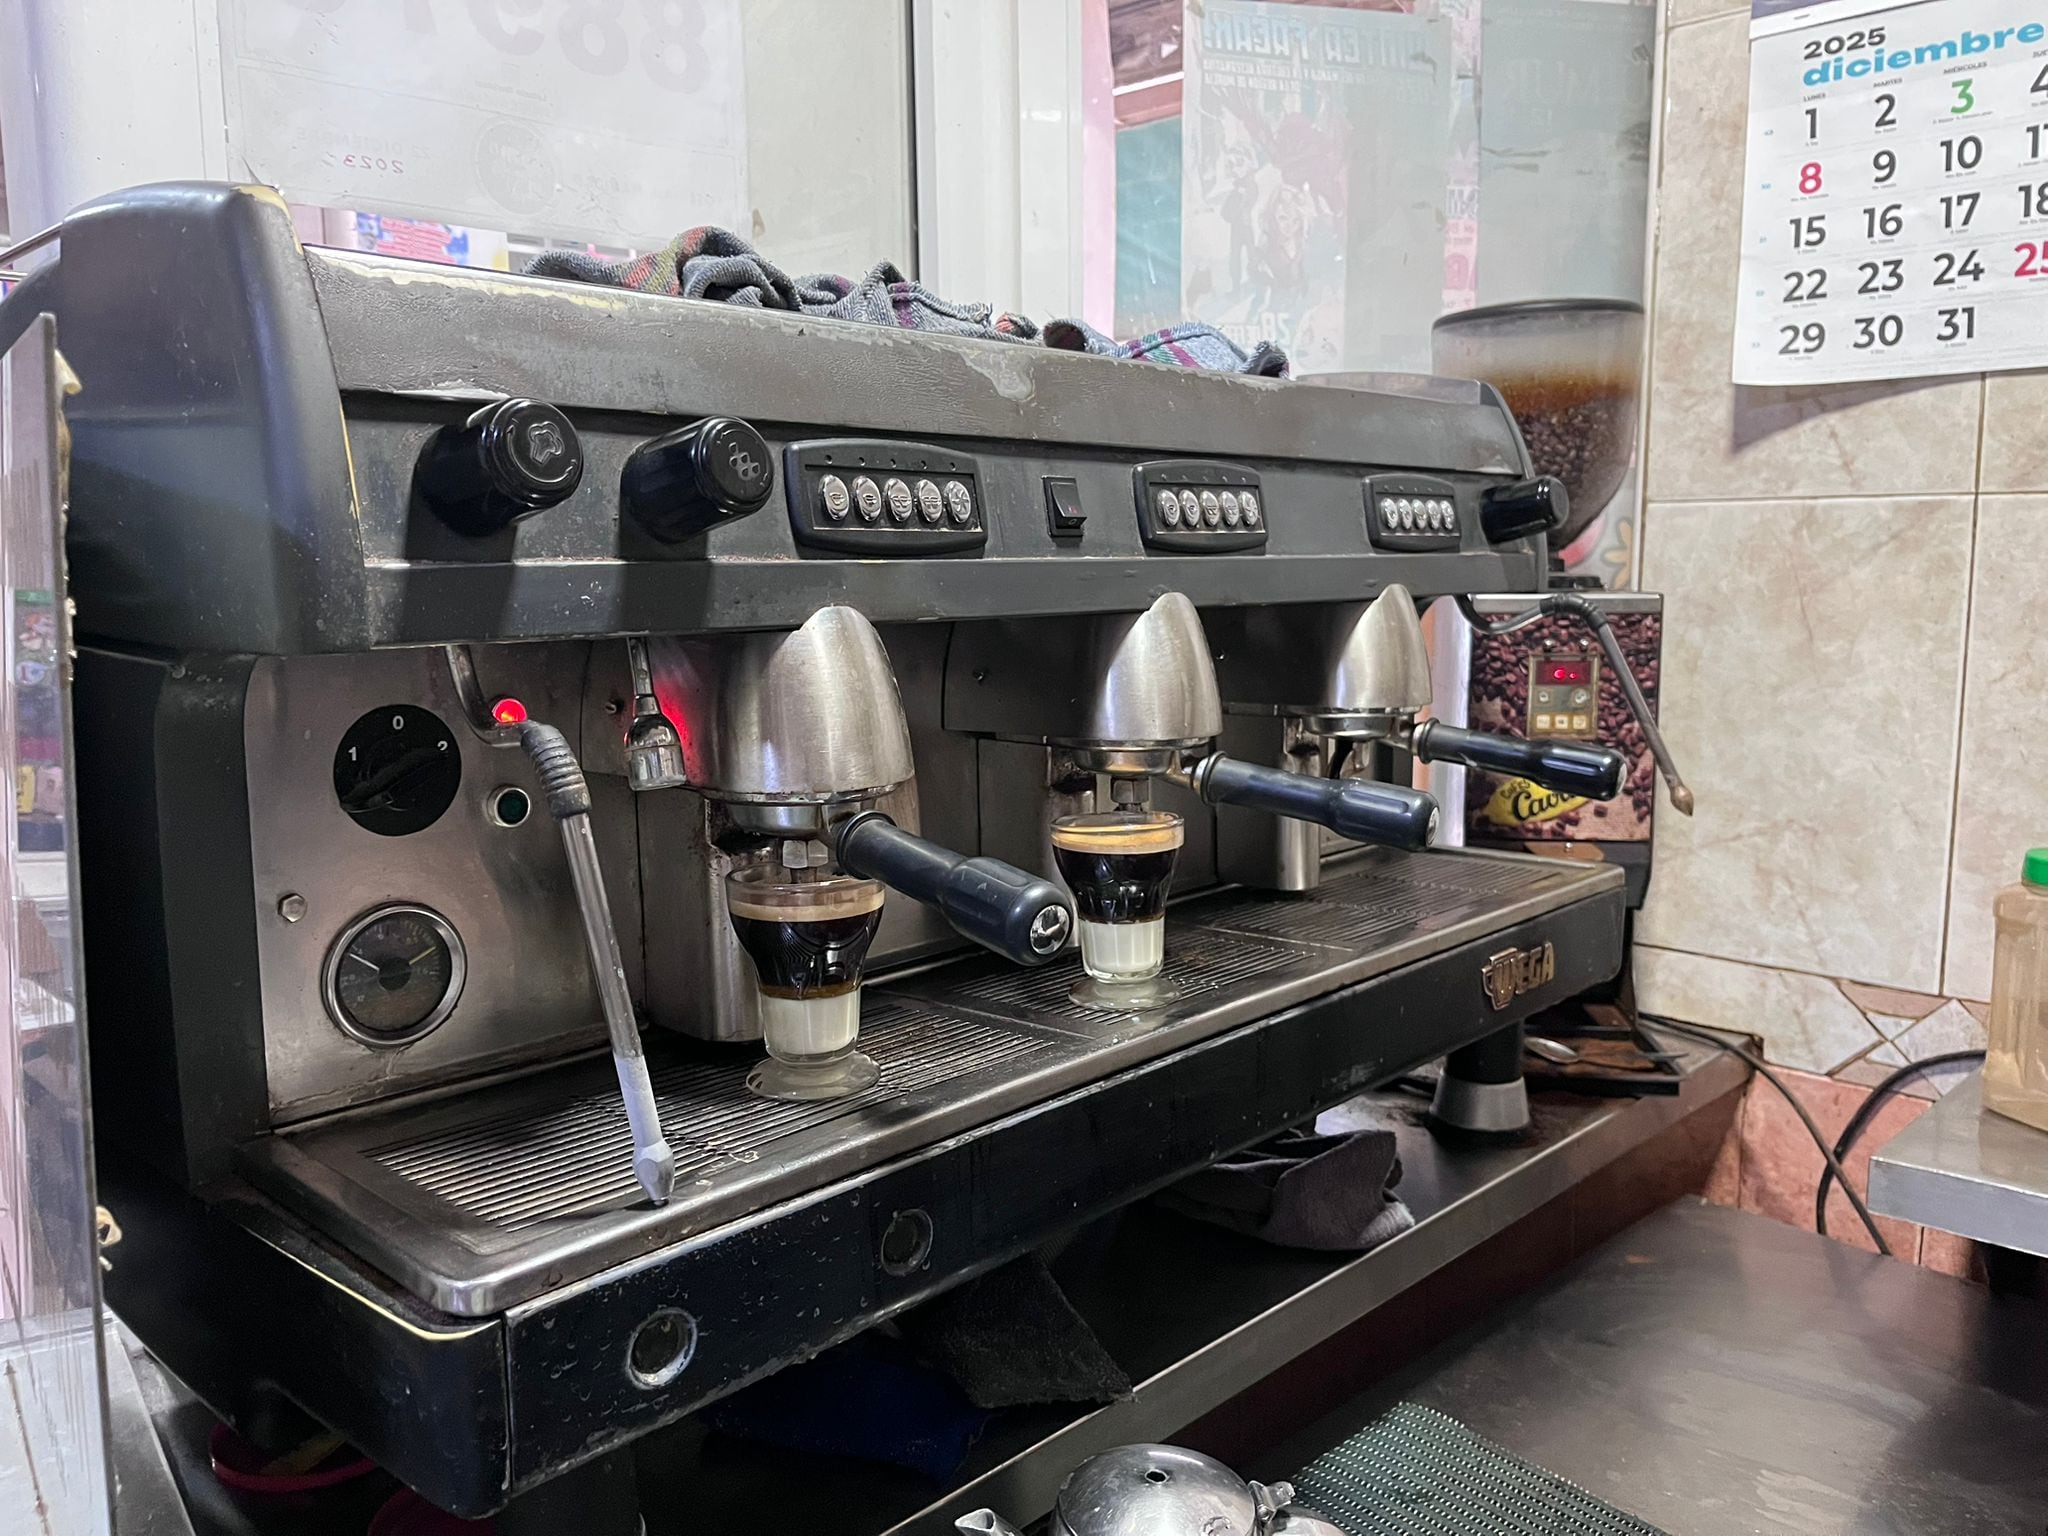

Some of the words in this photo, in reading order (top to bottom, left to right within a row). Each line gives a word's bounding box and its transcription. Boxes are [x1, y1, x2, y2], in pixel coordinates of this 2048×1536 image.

[1803, 26, 1886, 60] 2025
[1803, 22, 2045, 86] diciembre
[1804, 107, 1818, 139] 1
[1874, 93, 1898, 127] 2
[1951, 78, 1975, 114] 3
[1798, 162, 1822, 194] 8
[1873, 149, 1896, 183] 9
[1940, 135, 1983, 172] 10
[1790, 214, 1826, 248] 15
[1863, 204, 1903, 239] 16
[1940, 191, 1981, 229] 17
[1783, 268, 1828, 303] 22
[1858, 259, 1904, 294] 23
[1933, 249, 1985, 286] 24
[1777, 322, 1826, 355] 29
[1853, 314, 1904, 349] 30
[1936, 306, 1975, 341] 31
[392, 715, 404, 730] 0
[348, 746, 357, 761] 1
